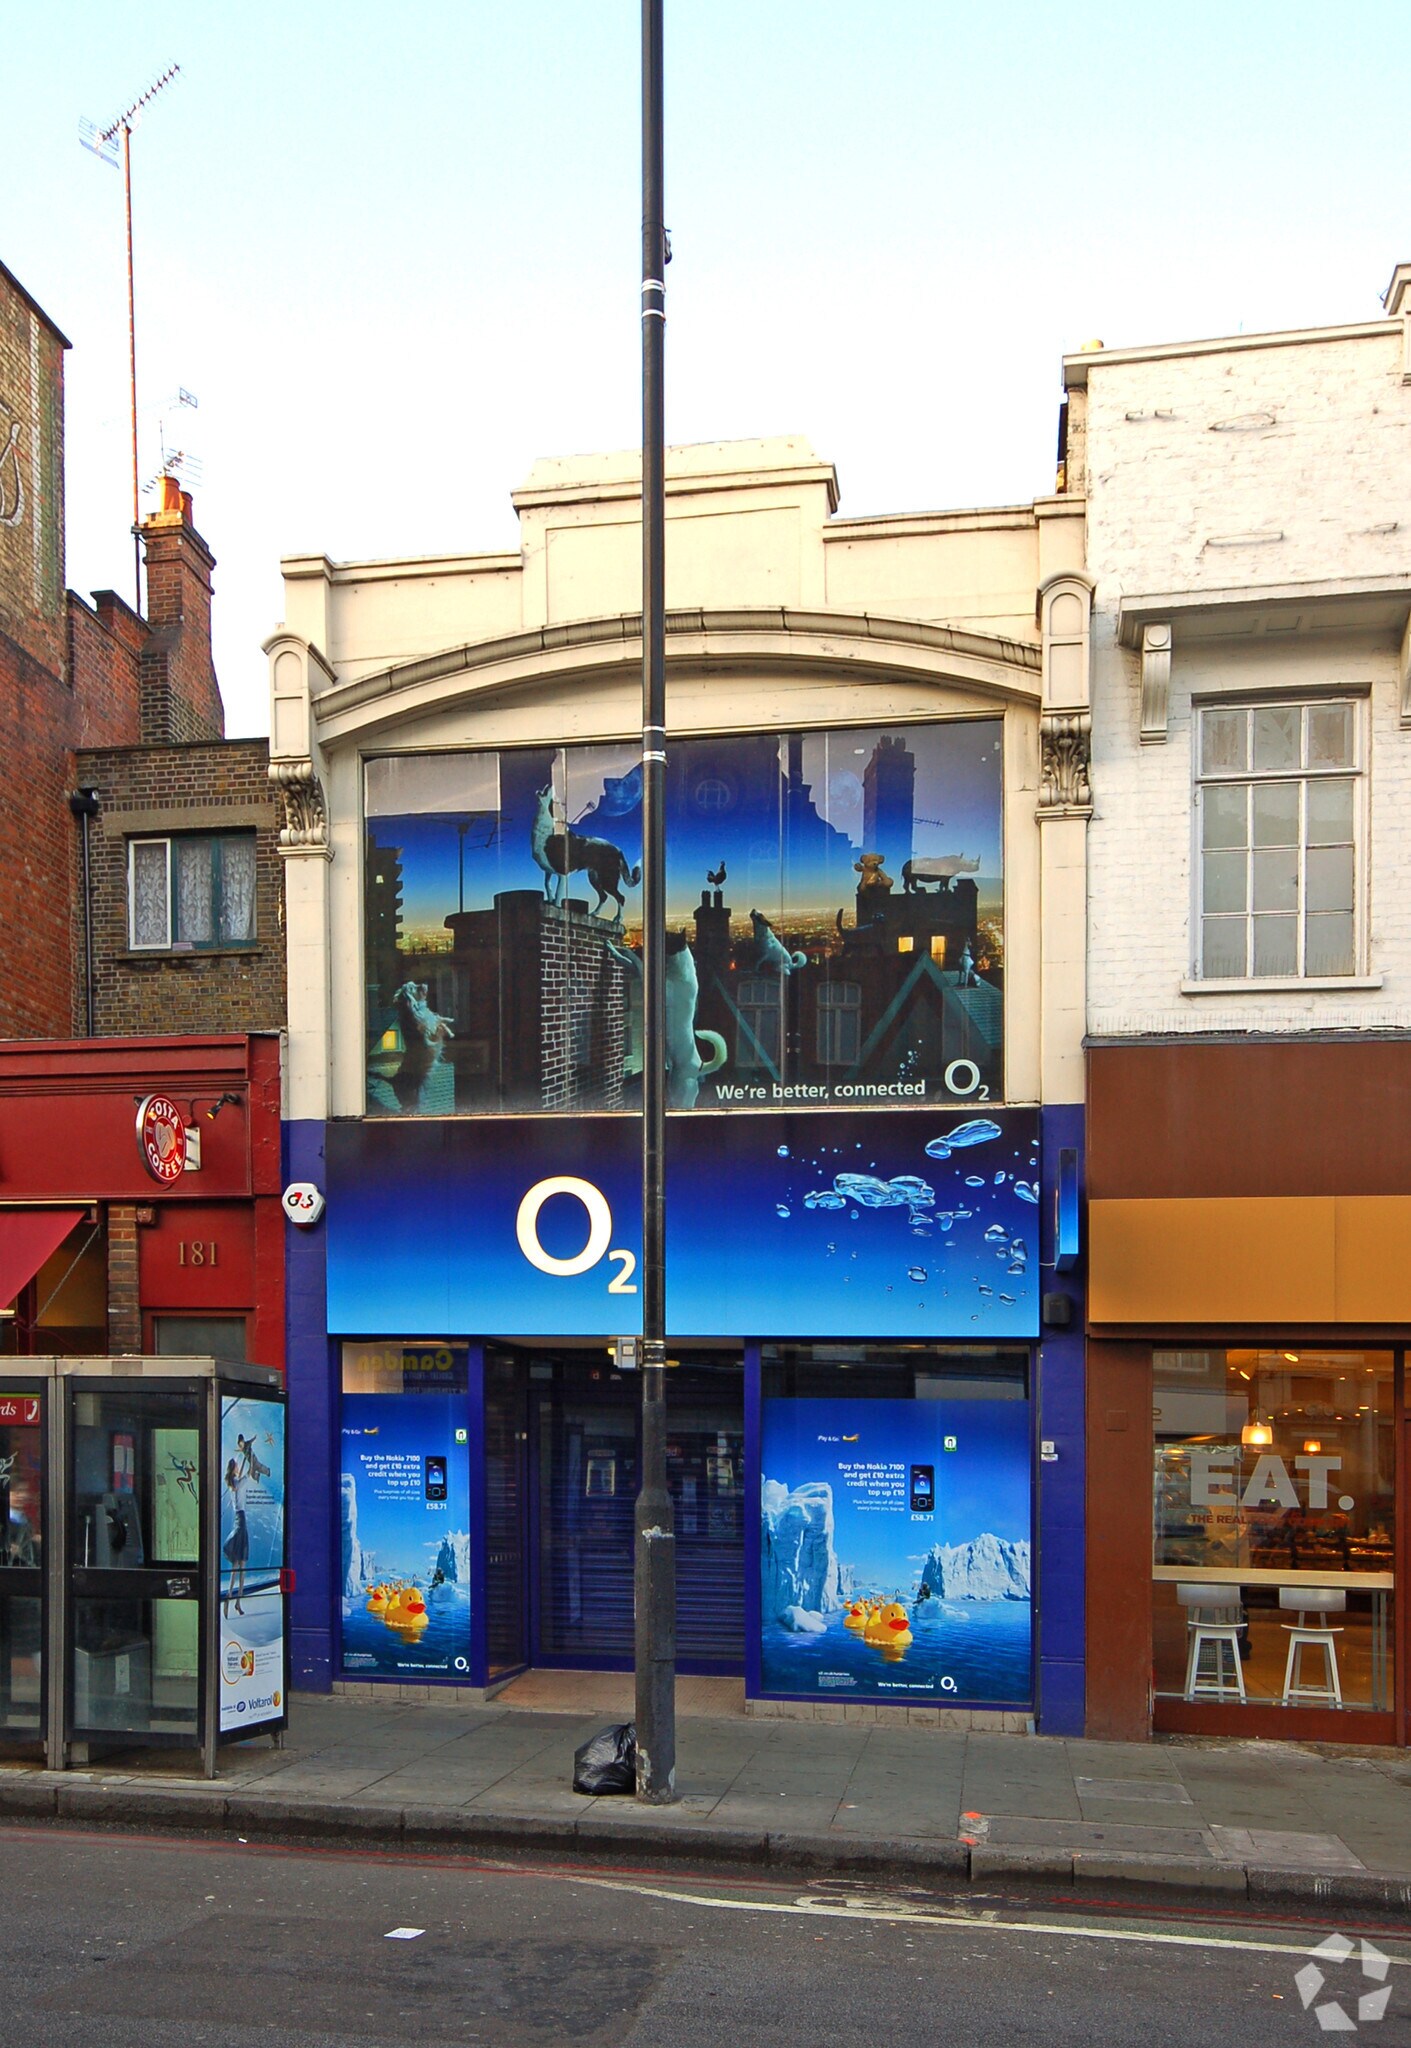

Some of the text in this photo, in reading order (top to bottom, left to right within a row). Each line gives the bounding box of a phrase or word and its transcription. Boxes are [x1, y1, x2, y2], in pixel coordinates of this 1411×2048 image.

[944, 1058, 990, 1101] O2
[772, 1082, 829, 1099] better,
[834, 1079, 926, 1097] connected
[147, 1101, 179, 1130] COSTA
[147, 1142, 183, 1177] COFFEE
[287, 1192, 314, 1209] G4S
[516, 1175, 638, 1294] O2
[178, 1240, 216, 1265] 181
[360, 1454, 373, 1462] Buy
[838, 1463, 852, 1471] Buy
[1191, 1453, 1355, 1511] EAT.
[868, 1489, 880, 1497] top
[1191, 1514, 1213, 1524] THE
[1216, 1515, 1247, 1524] REAL
[454, 1656, 470, 1672] O2
[940, 1676, 958, 1693] O2
[249, 1695, 272, 1710] Voltarol
